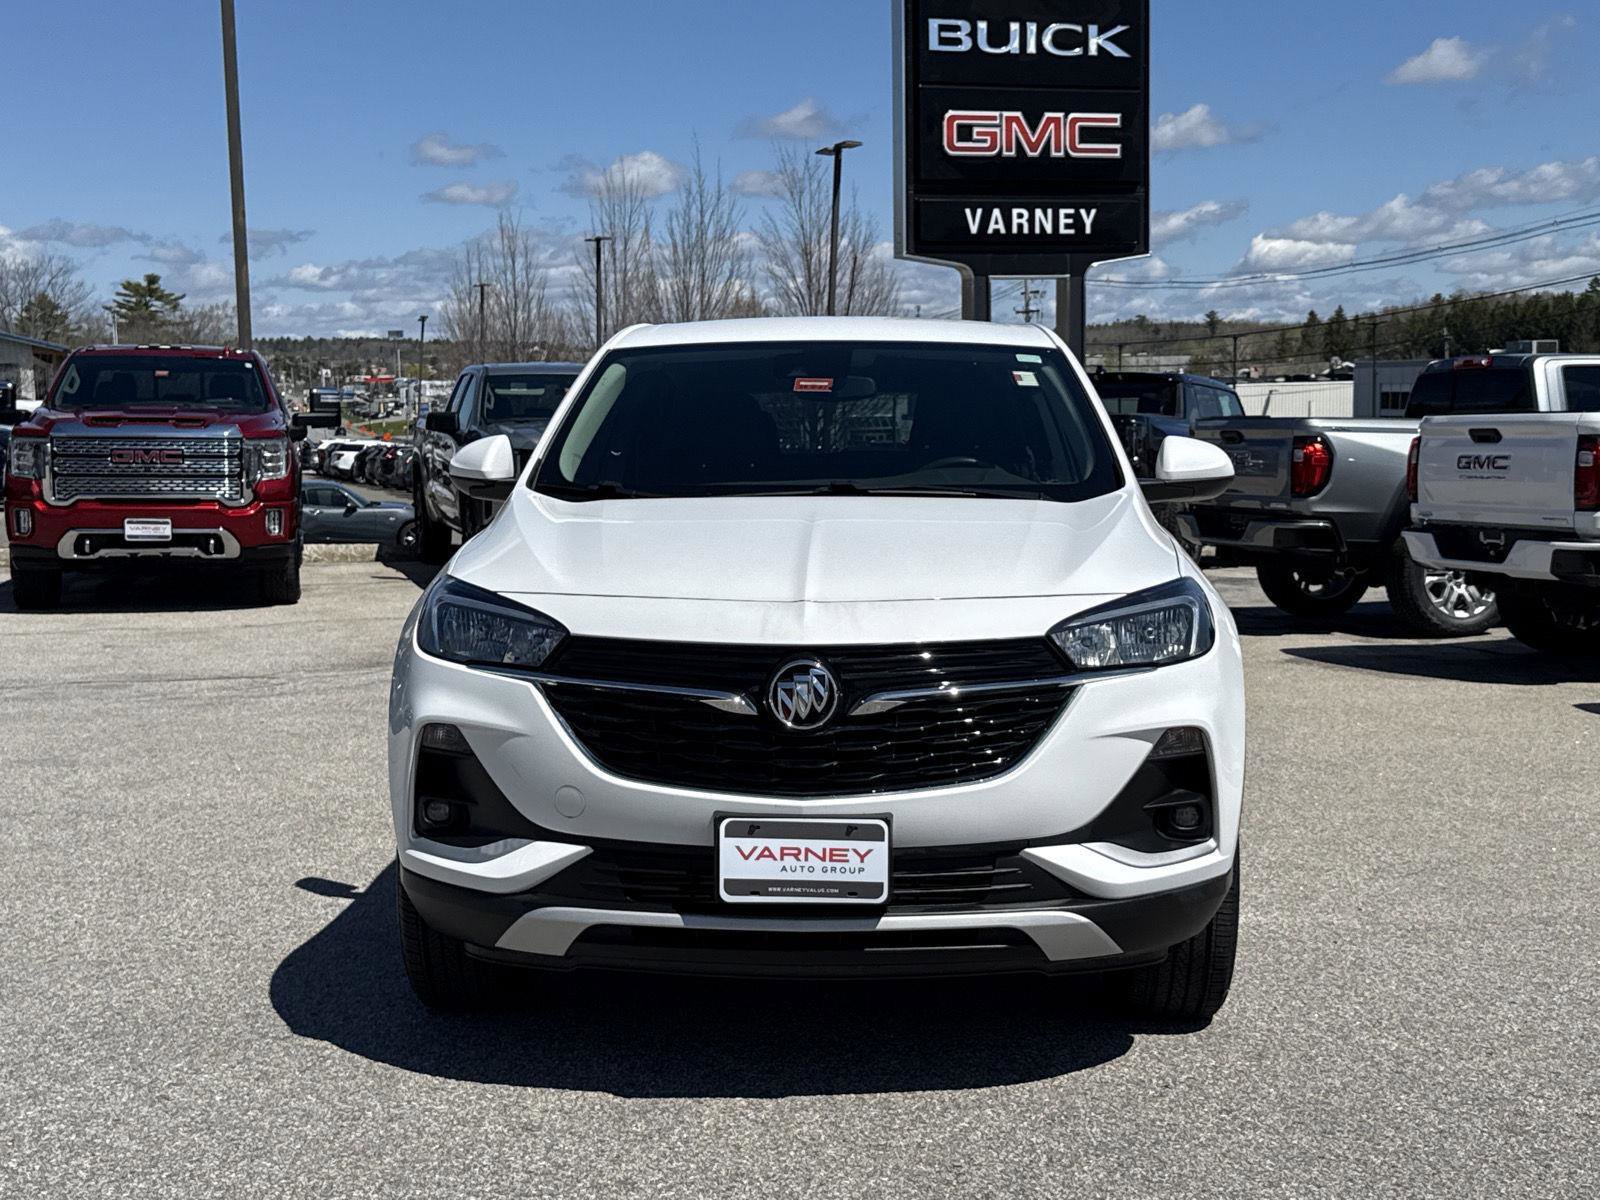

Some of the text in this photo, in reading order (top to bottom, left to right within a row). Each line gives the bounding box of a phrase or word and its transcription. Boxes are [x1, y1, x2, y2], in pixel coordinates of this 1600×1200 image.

[928, 18, 1132, 58] BUICK
[943, 109, 1122, 158] GMC
[964, 208, 1098, 235] VARNEY
[112, 450, 182, 464] GMC
[1457, 455, 1511, 470] GMC
[735, 845, 874, 863] VARNEY
[780, 865, 866, 874] AUTO GROUP
